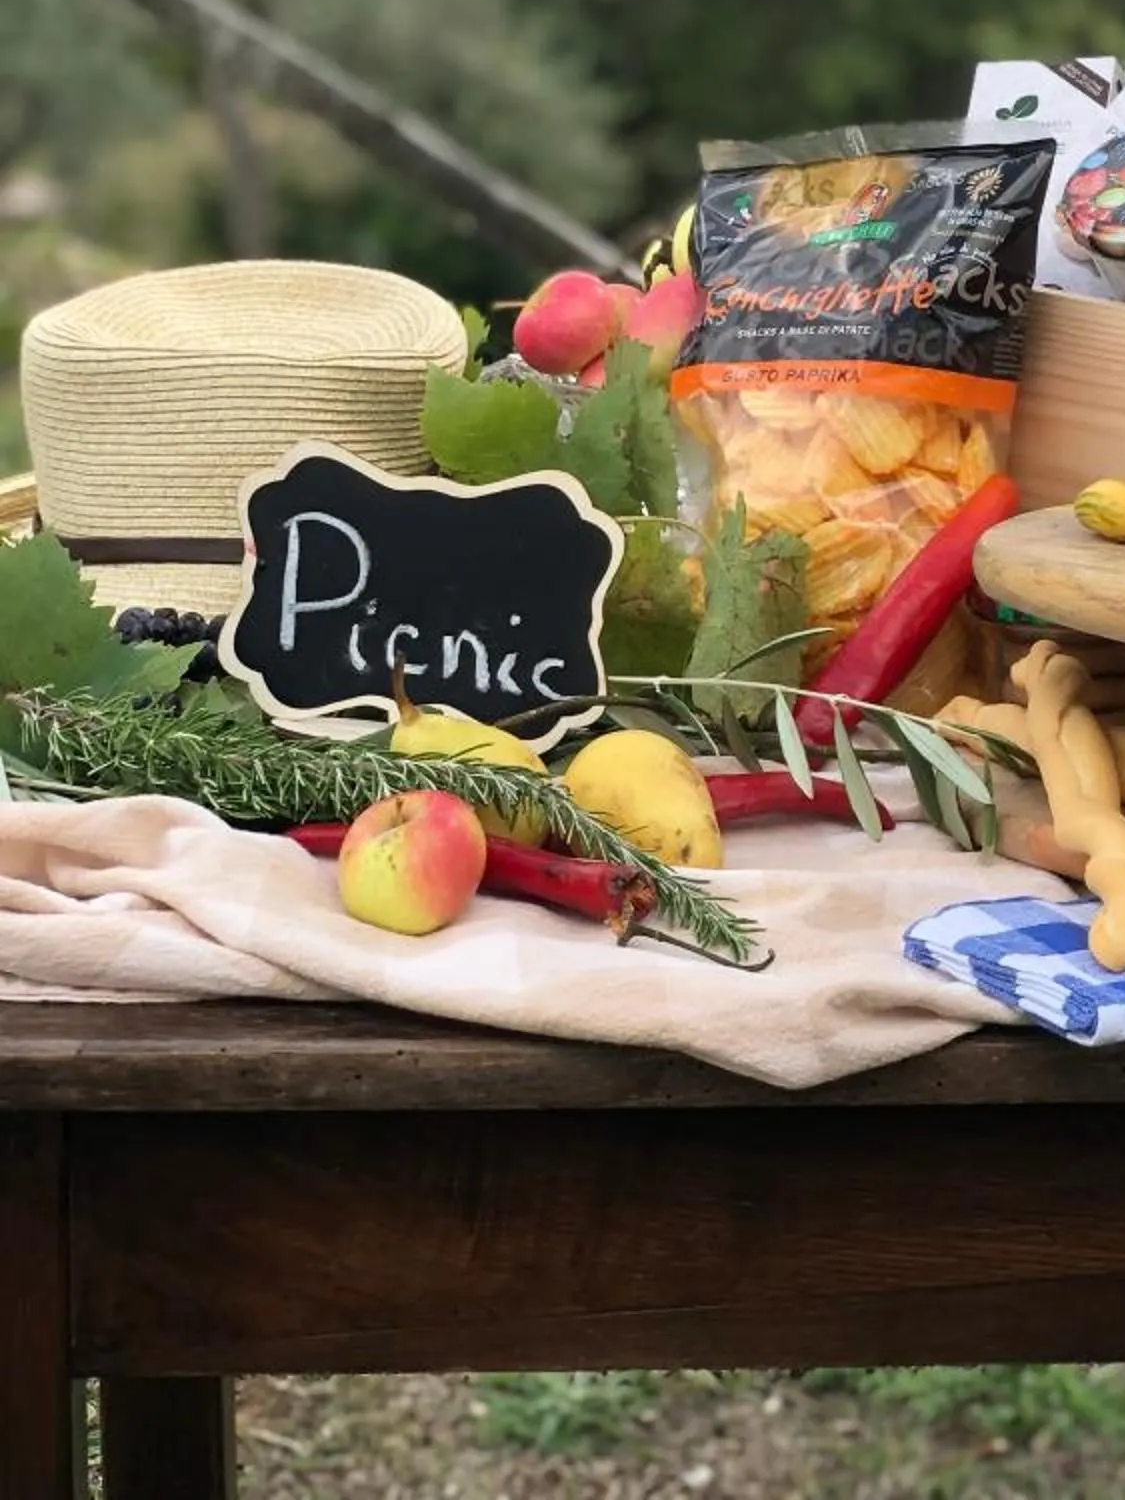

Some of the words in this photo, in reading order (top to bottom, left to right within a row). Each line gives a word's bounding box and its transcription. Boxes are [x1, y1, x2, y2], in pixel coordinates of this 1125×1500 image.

[736, 326, 777, 338] SNACKS
[779, 326, 786, 336] A
[831, 325, 872, 336] PATATE
[722, 368, 780, 383] GUSTO
[785, 367, 861, 383] PAPRIKA
[280, 511, 568, 701] Picnic
